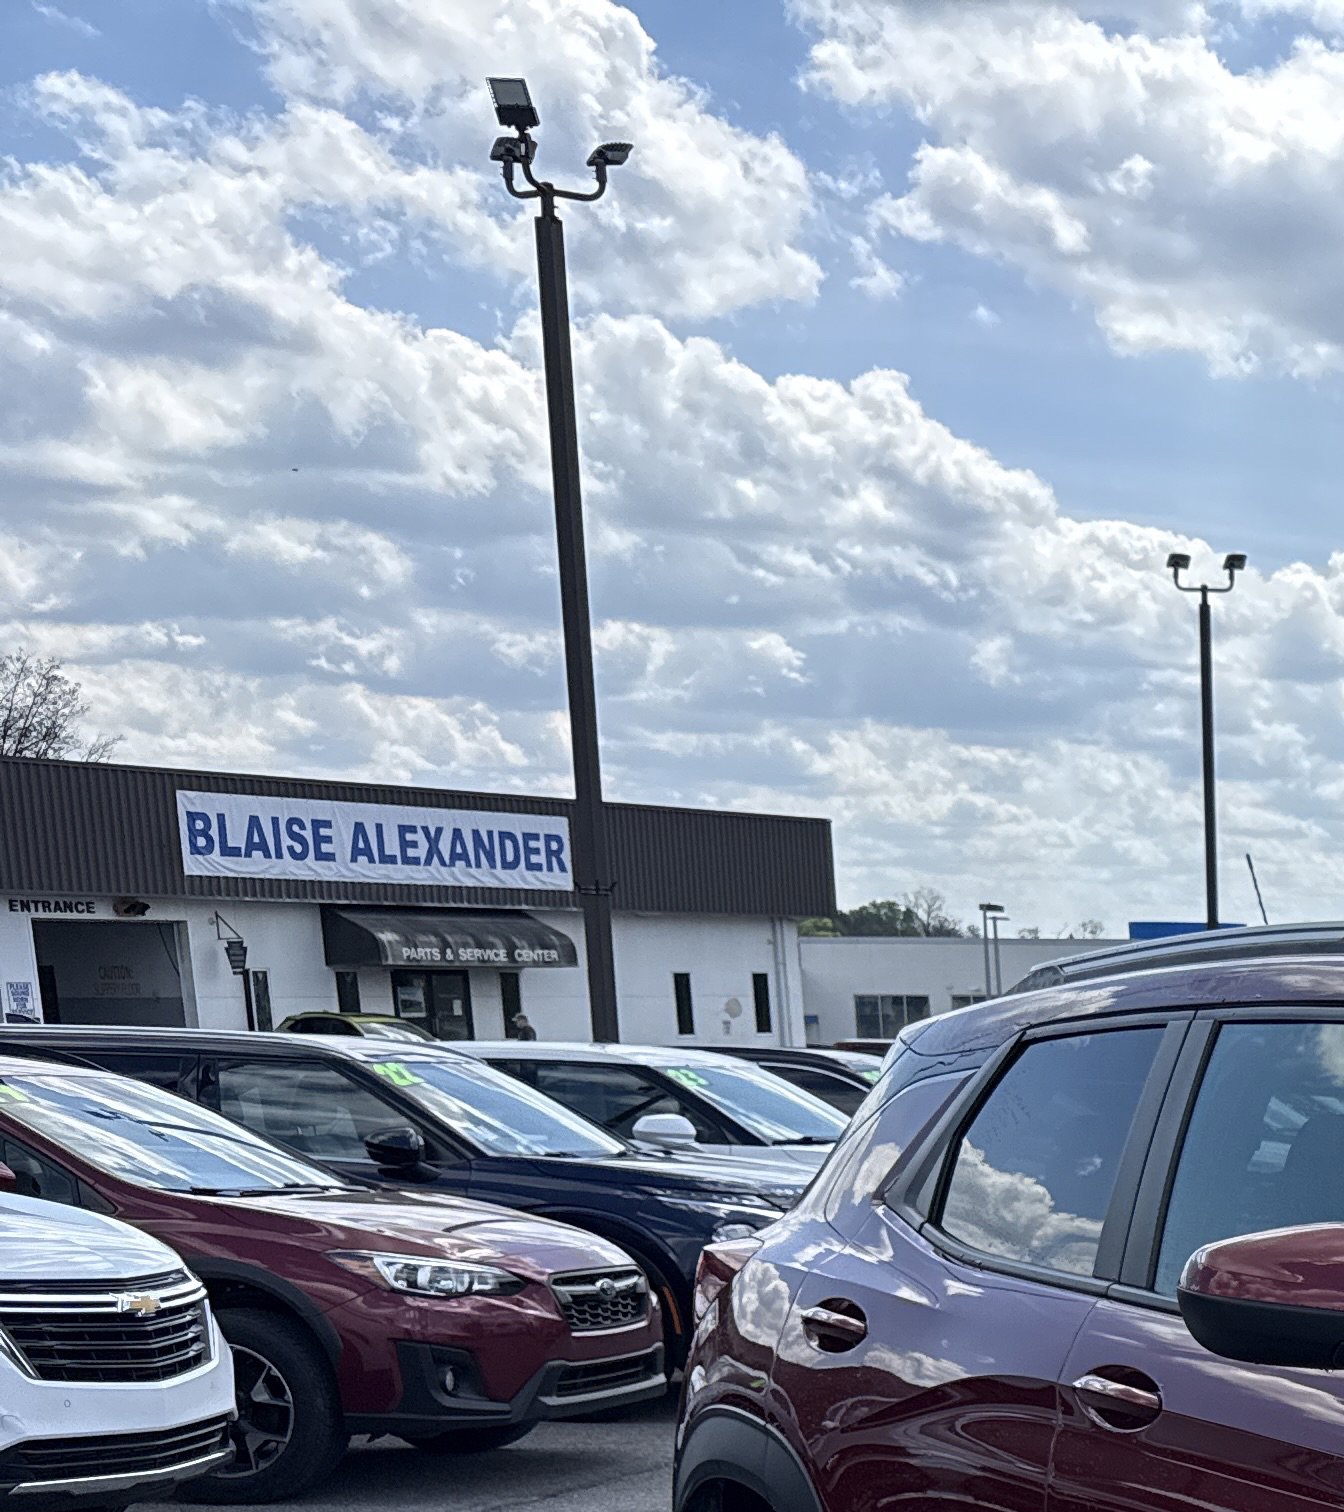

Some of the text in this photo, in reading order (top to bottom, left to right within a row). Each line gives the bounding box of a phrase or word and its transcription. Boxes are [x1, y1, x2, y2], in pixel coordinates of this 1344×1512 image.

[186, 810, 569, 873] BLAISE ALEXANDER
[8, 899, 96, 914] ENTRANCE
[402, 947, 560, 962] PARTS & SERVICE CENTER
